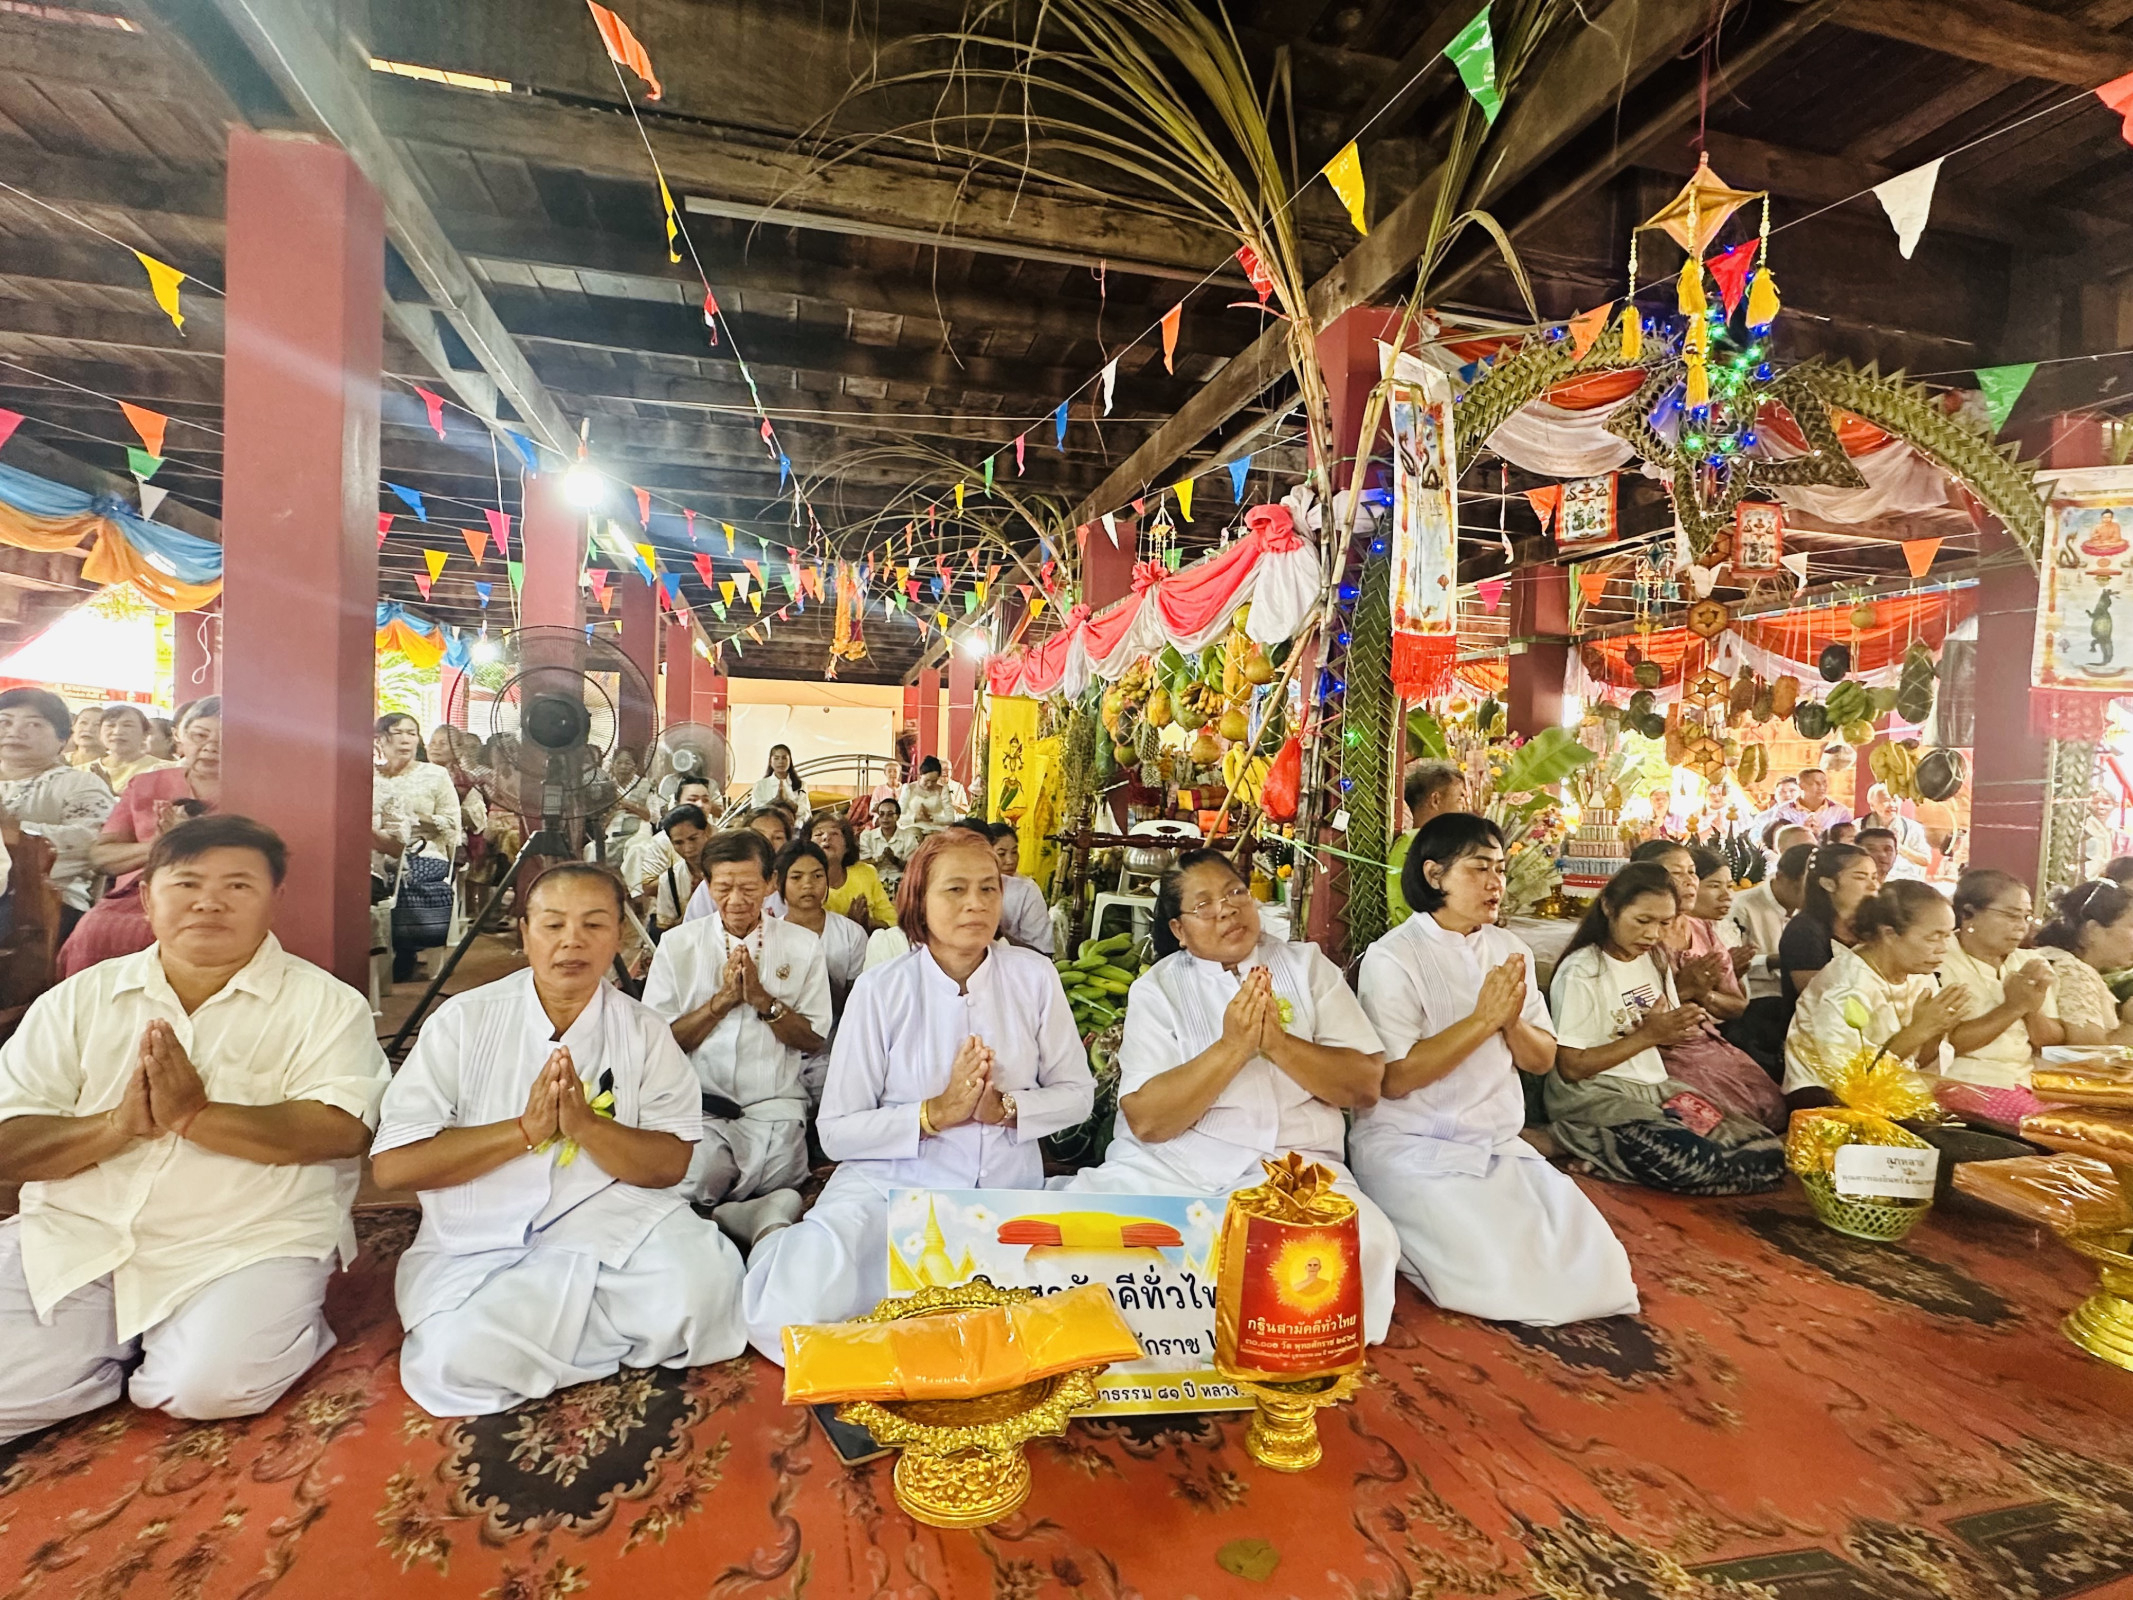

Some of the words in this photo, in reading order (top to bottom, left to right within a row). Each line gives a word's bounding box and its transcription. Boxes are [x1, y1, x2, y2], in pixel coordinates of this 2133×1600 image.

[1247, 1313, 1357, 1336] กฐินสามัคคีทั่วไทย
[1158, 1387, 1180, 1400] ๘๑
[1183, 1381, 1196, 1398] ปี
